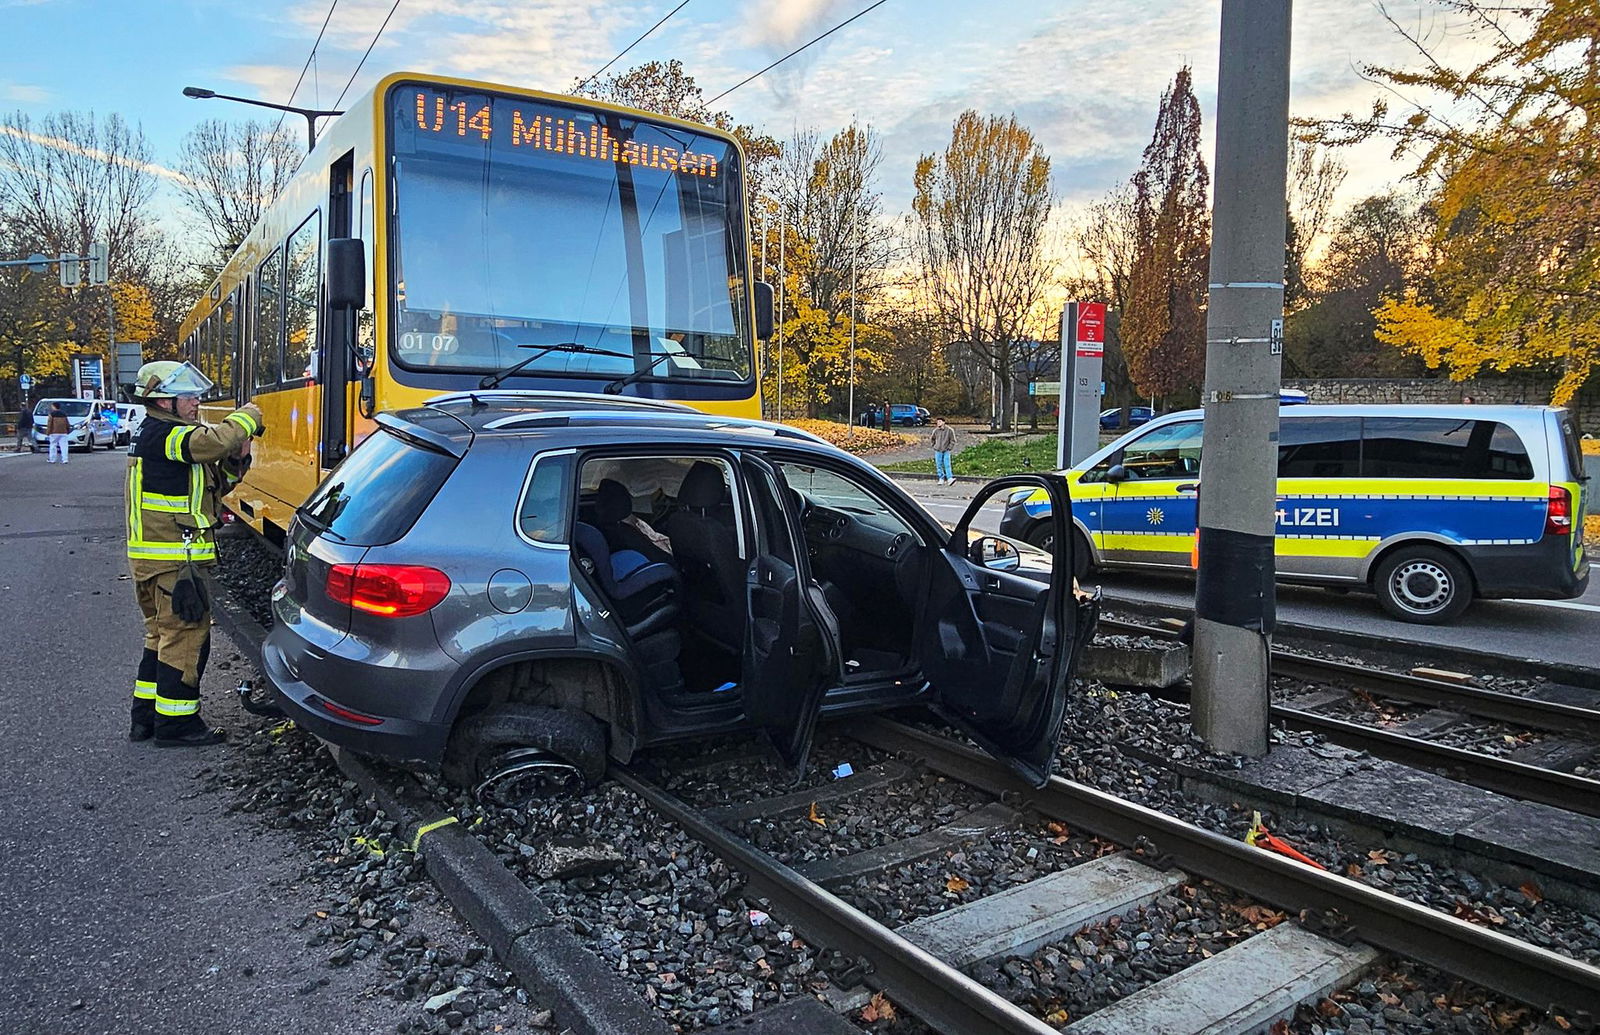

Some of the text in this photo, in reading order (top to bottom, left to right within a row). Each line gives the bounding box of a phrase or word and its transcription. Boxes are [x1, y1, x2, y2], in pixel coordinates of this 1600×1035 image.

[416, 92, 718, 178] U14 Mühlhausen
[403, 334, 455, 351] 01 07
[1275, 508, 1339, 526] LIZEI
